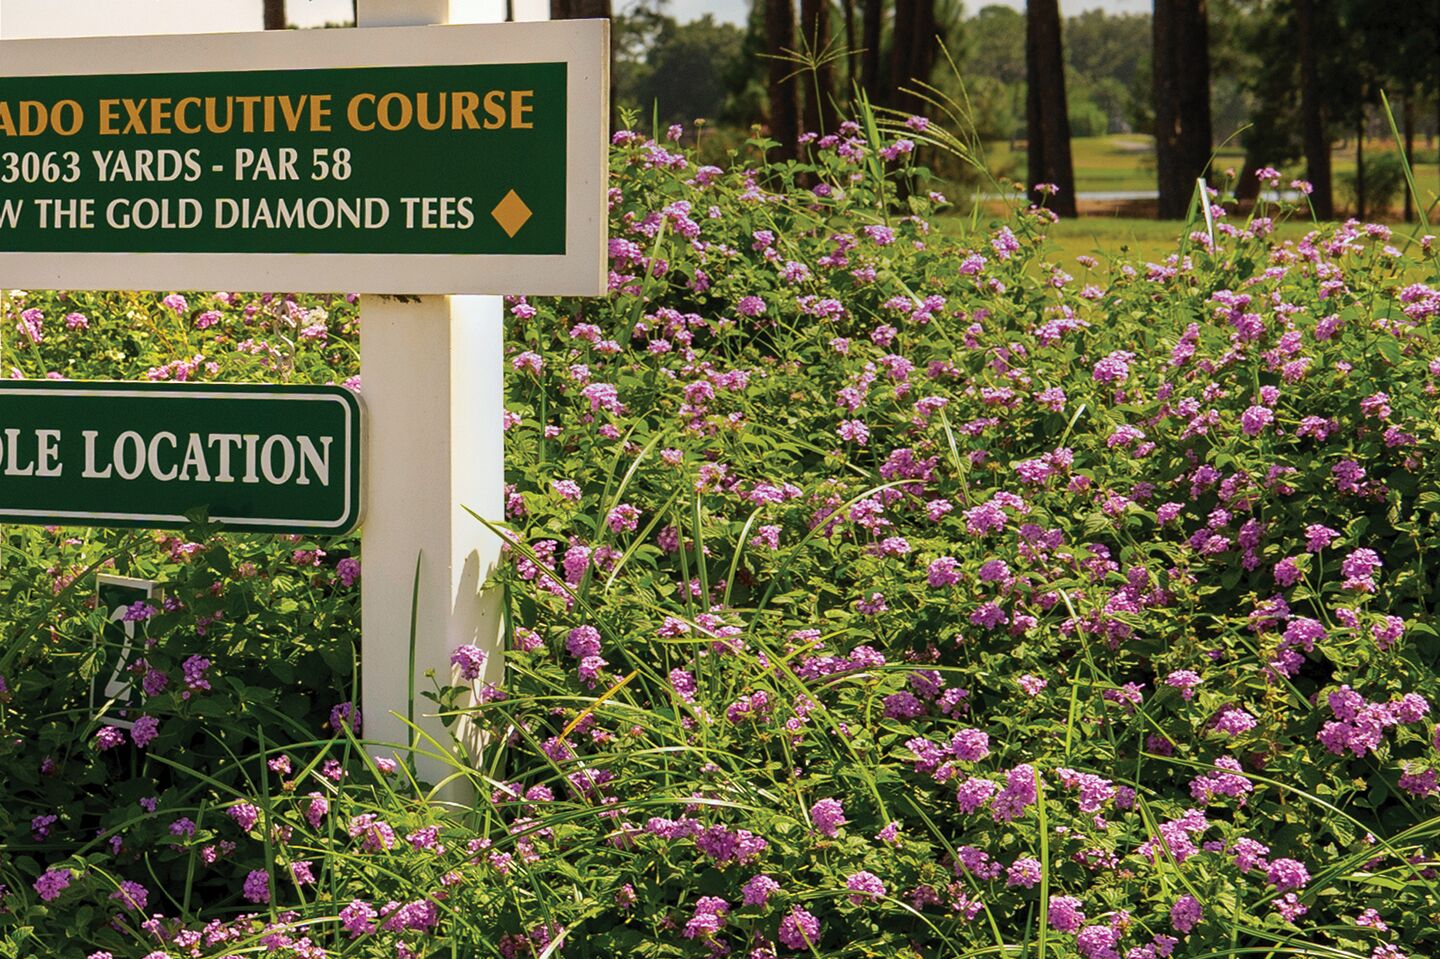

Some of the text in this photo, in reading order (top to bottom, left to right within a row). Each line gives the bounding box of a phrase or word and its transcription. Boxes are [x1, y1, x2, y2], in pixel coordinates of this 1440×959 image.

[100, 95, 331, 134] EXECUTIVE
[348, 91, 533, 131] COURSE
[2, 152, 80, 183] 3063
[93, 149, 201, 181] YARDS
[236, 148, 299, 180] PAR
[311, 148, 351, 180] 58
[35, 199, 94, 228] THE
[107, 198, 202, 229] GOLD
[215, 198, 389, 229] DIAMOND
[400, 197, 474, 229] TEES
[82, 431, 332, 486] LOCATION
